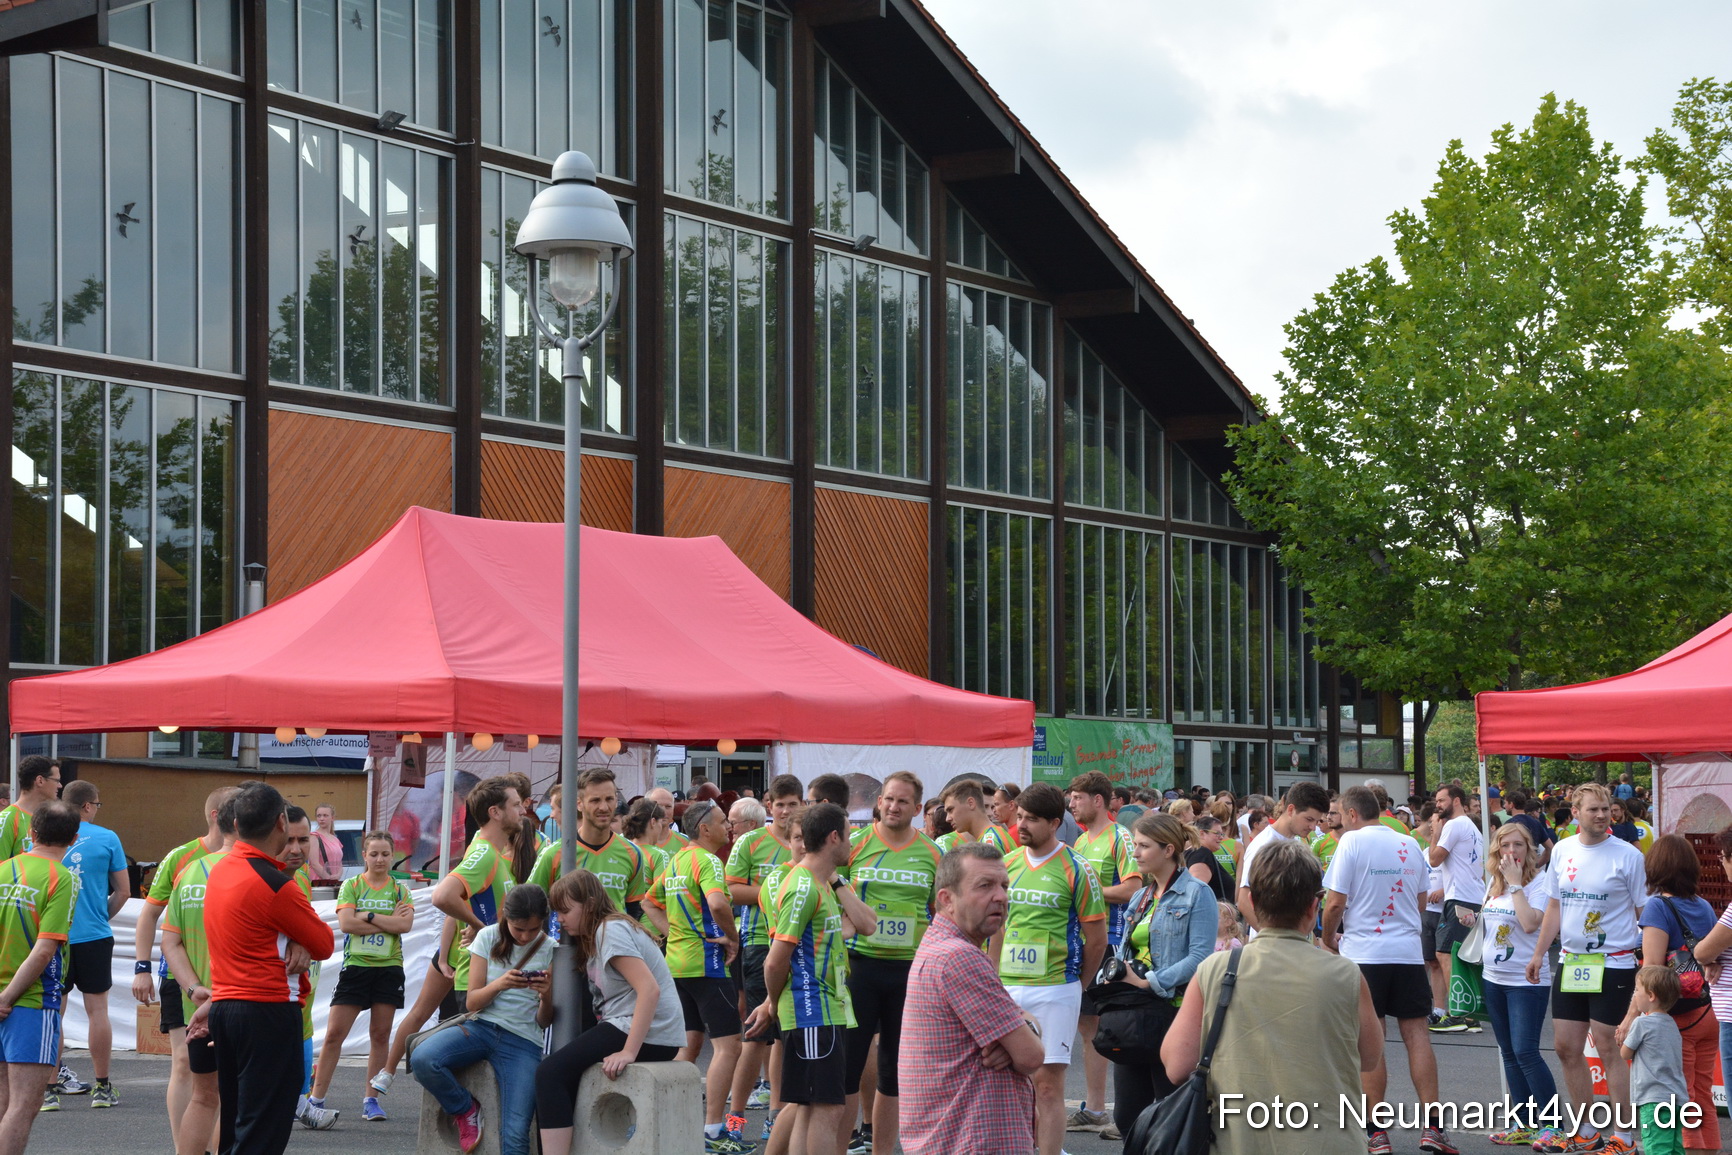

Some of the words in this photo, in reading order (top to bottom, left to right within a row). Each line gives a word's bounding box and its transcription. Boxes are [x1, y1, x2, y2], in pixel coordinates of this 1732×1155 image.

[857, 867, 929, 888] BOCK
[1370, 868, 1402, 876] Firmenlauf
[790, 876, 811, 924] BOCK
[877, 920, 907, 936] 139
[360, 933, 385, 947] 149
[1009, 947, 1037, 964] 140
[1574, 968, 1590, 982] 95
